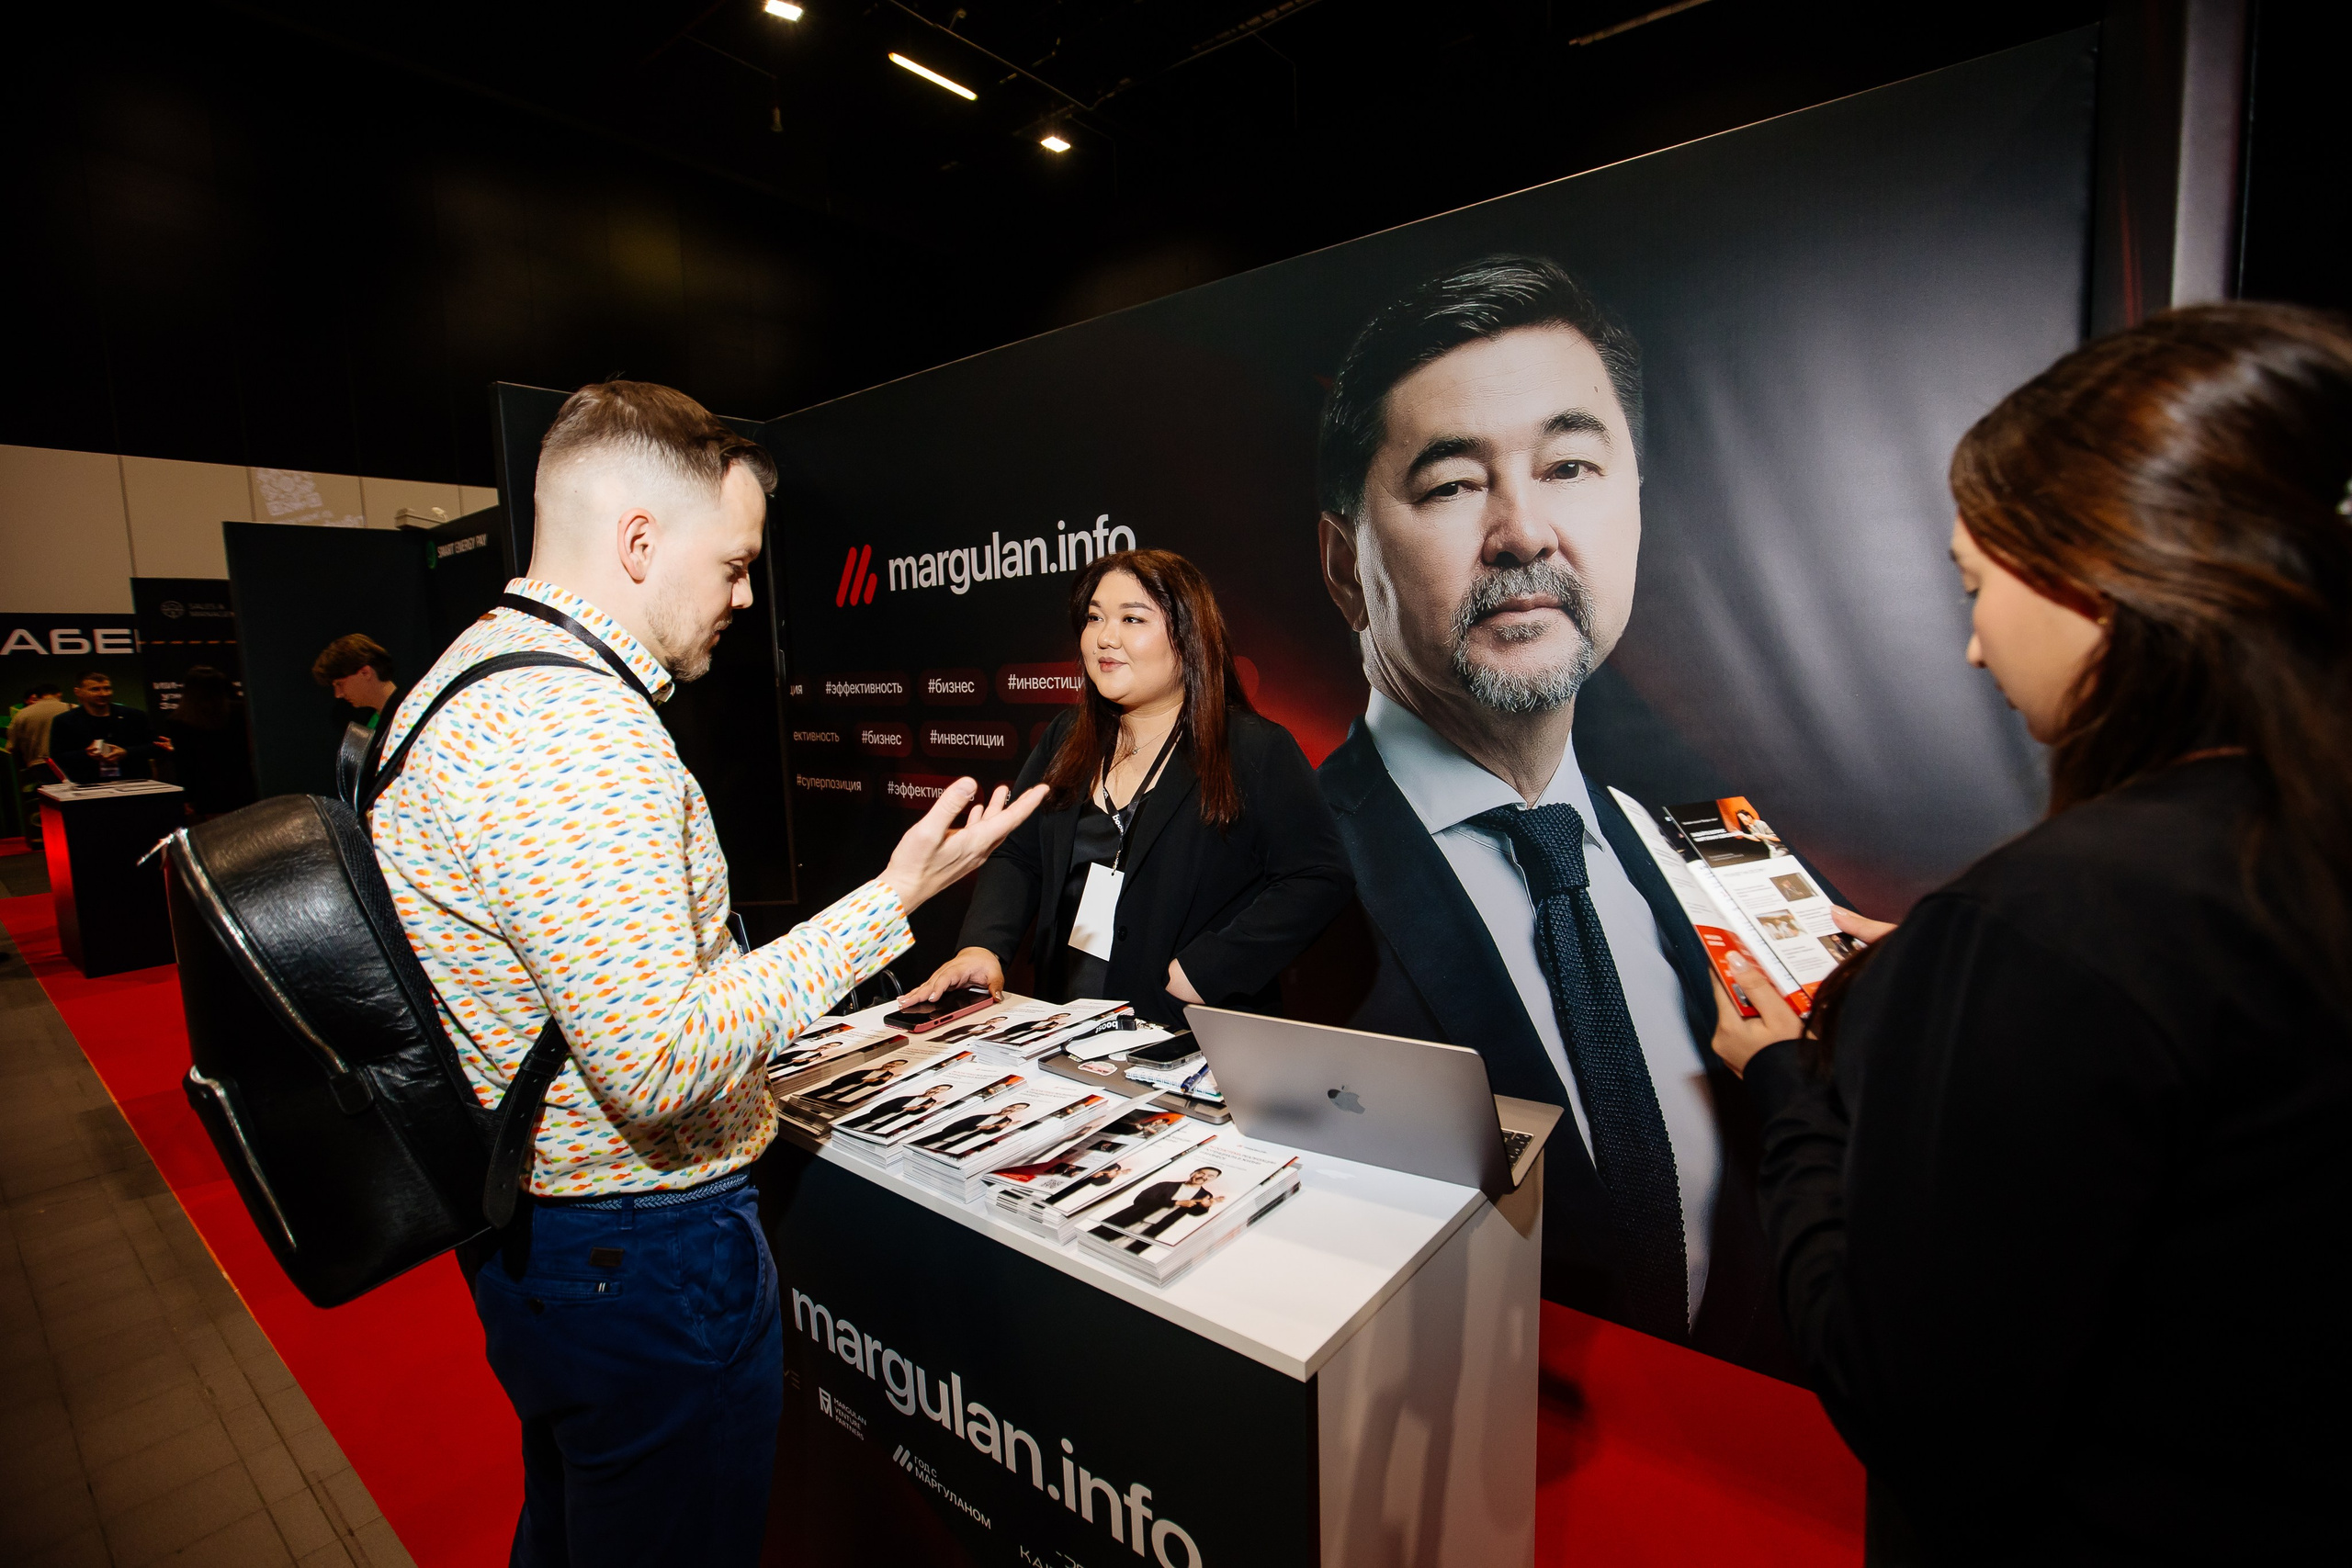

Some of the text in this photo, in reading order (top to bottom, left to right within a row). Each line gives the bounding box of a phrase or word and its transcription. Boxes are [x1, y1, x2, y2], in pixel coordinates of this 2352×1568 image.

[888, 513, 1136, 595] margulan.info
[825, 681, 903, 697] #эффективность
[928, 678, 975, 694] #бизнес
[861, 728, 902, 746] #бизнес
[930, 729, 1004, 749] #инвестиции
[796, 773, 862, 793] #суперпозиция
[833, 1397, 867, 1427] MARGULAN
[834, 1407, 862, 1430] VENTURE
[792, 1287, 1203, 1568] margulan.info
[835, 1416, 865, 1441] PARTNERS
[914, 1456, 931, 1475] ГОД
[914, 1467, 991, 1529] МАРГУЛАНОМ
